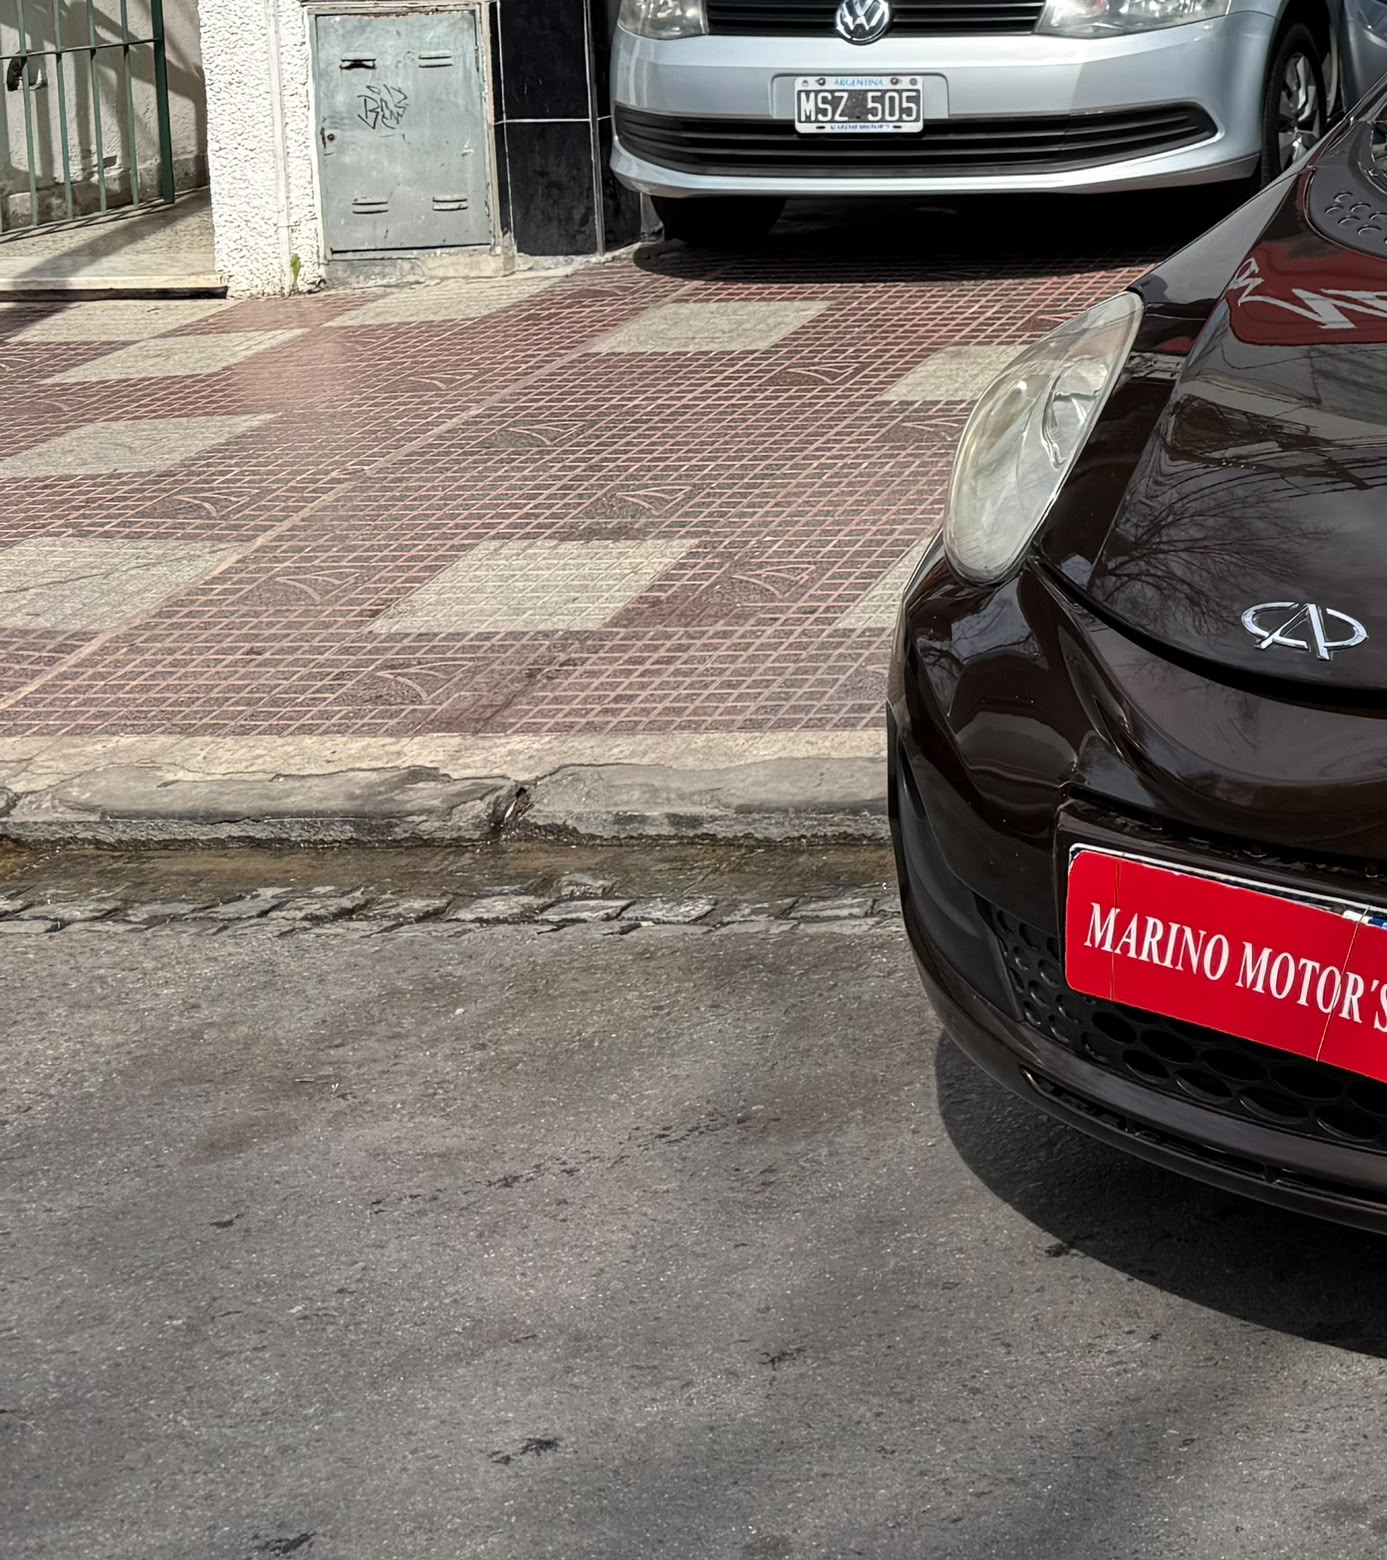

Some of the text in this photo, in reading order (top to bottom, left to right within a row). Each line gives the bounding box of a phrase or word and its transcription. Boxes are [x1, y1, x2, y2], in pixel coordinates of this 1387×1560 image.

[800, 92, 917, 121] MSZ 505
[1083, 902, 1230, 981] MARINO
